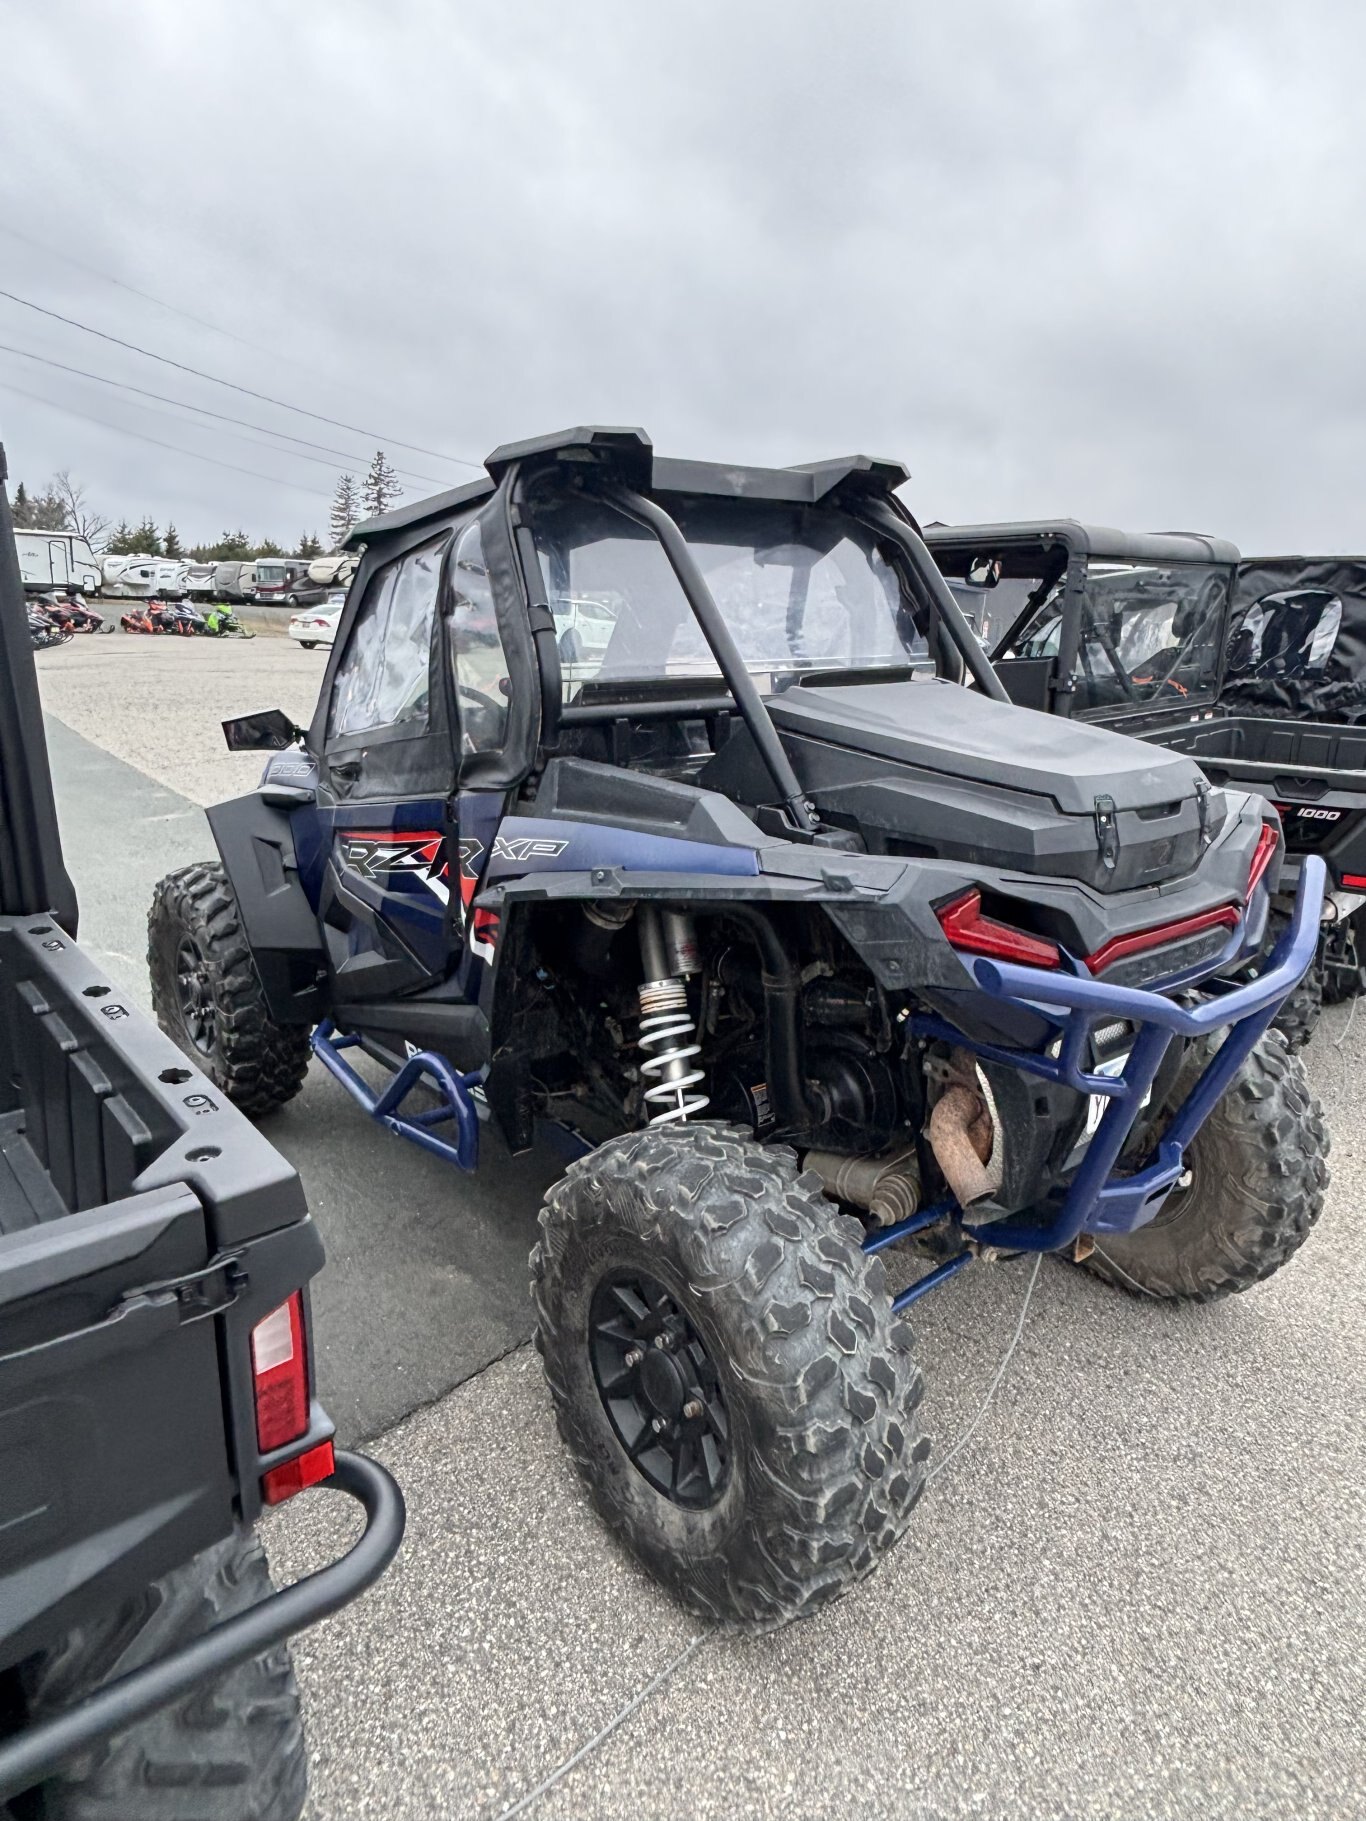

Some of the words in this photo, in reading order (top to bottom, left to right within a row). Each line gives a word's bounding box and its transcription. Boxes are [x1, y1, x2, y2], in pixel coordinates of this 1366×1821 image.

[1297, 807, 1341, 821] 1000
[342, 836, 484, 880] RZR
[490, 836, 570, 861] XP
